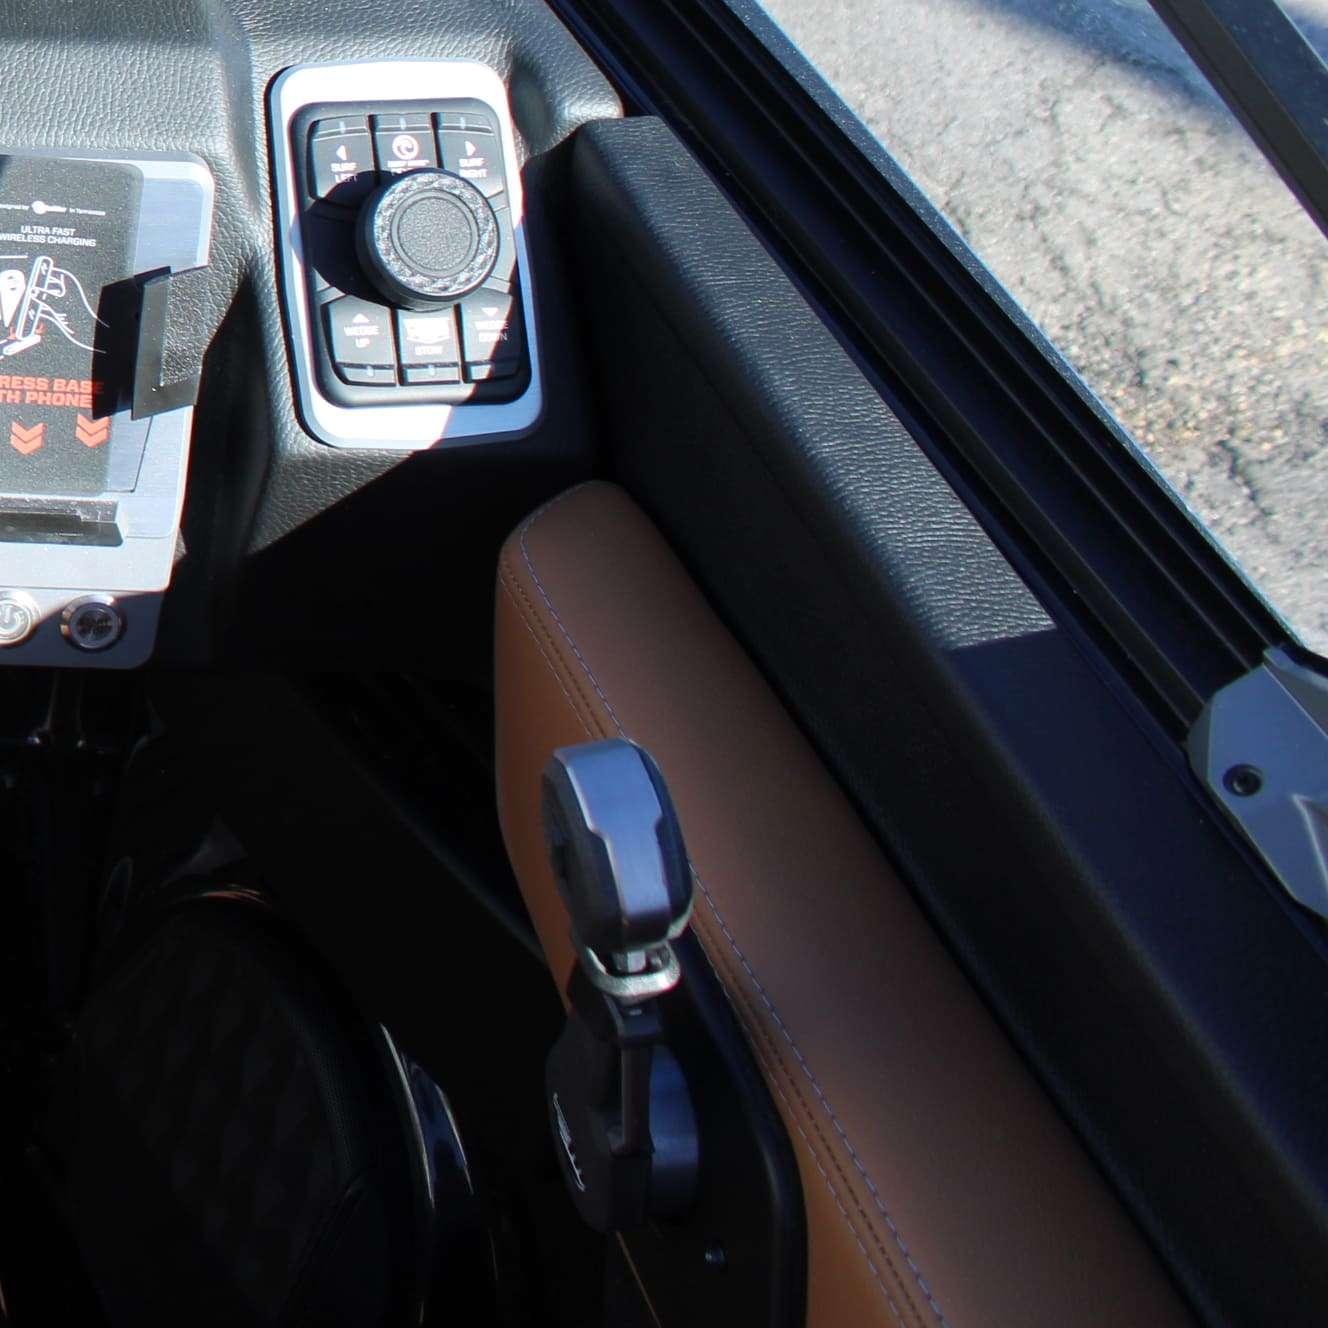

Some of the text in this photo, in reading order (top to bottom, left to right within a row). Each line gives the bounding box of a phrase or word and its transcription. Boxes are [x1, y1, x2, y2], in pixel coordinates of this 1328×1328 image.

[20, 225, 76, 236] ULTRA FAST
[47, 236, 97, 247] CHARGING
[52, 378, 105, 394] BASE
[25, 391, 94, 409] PHONE
